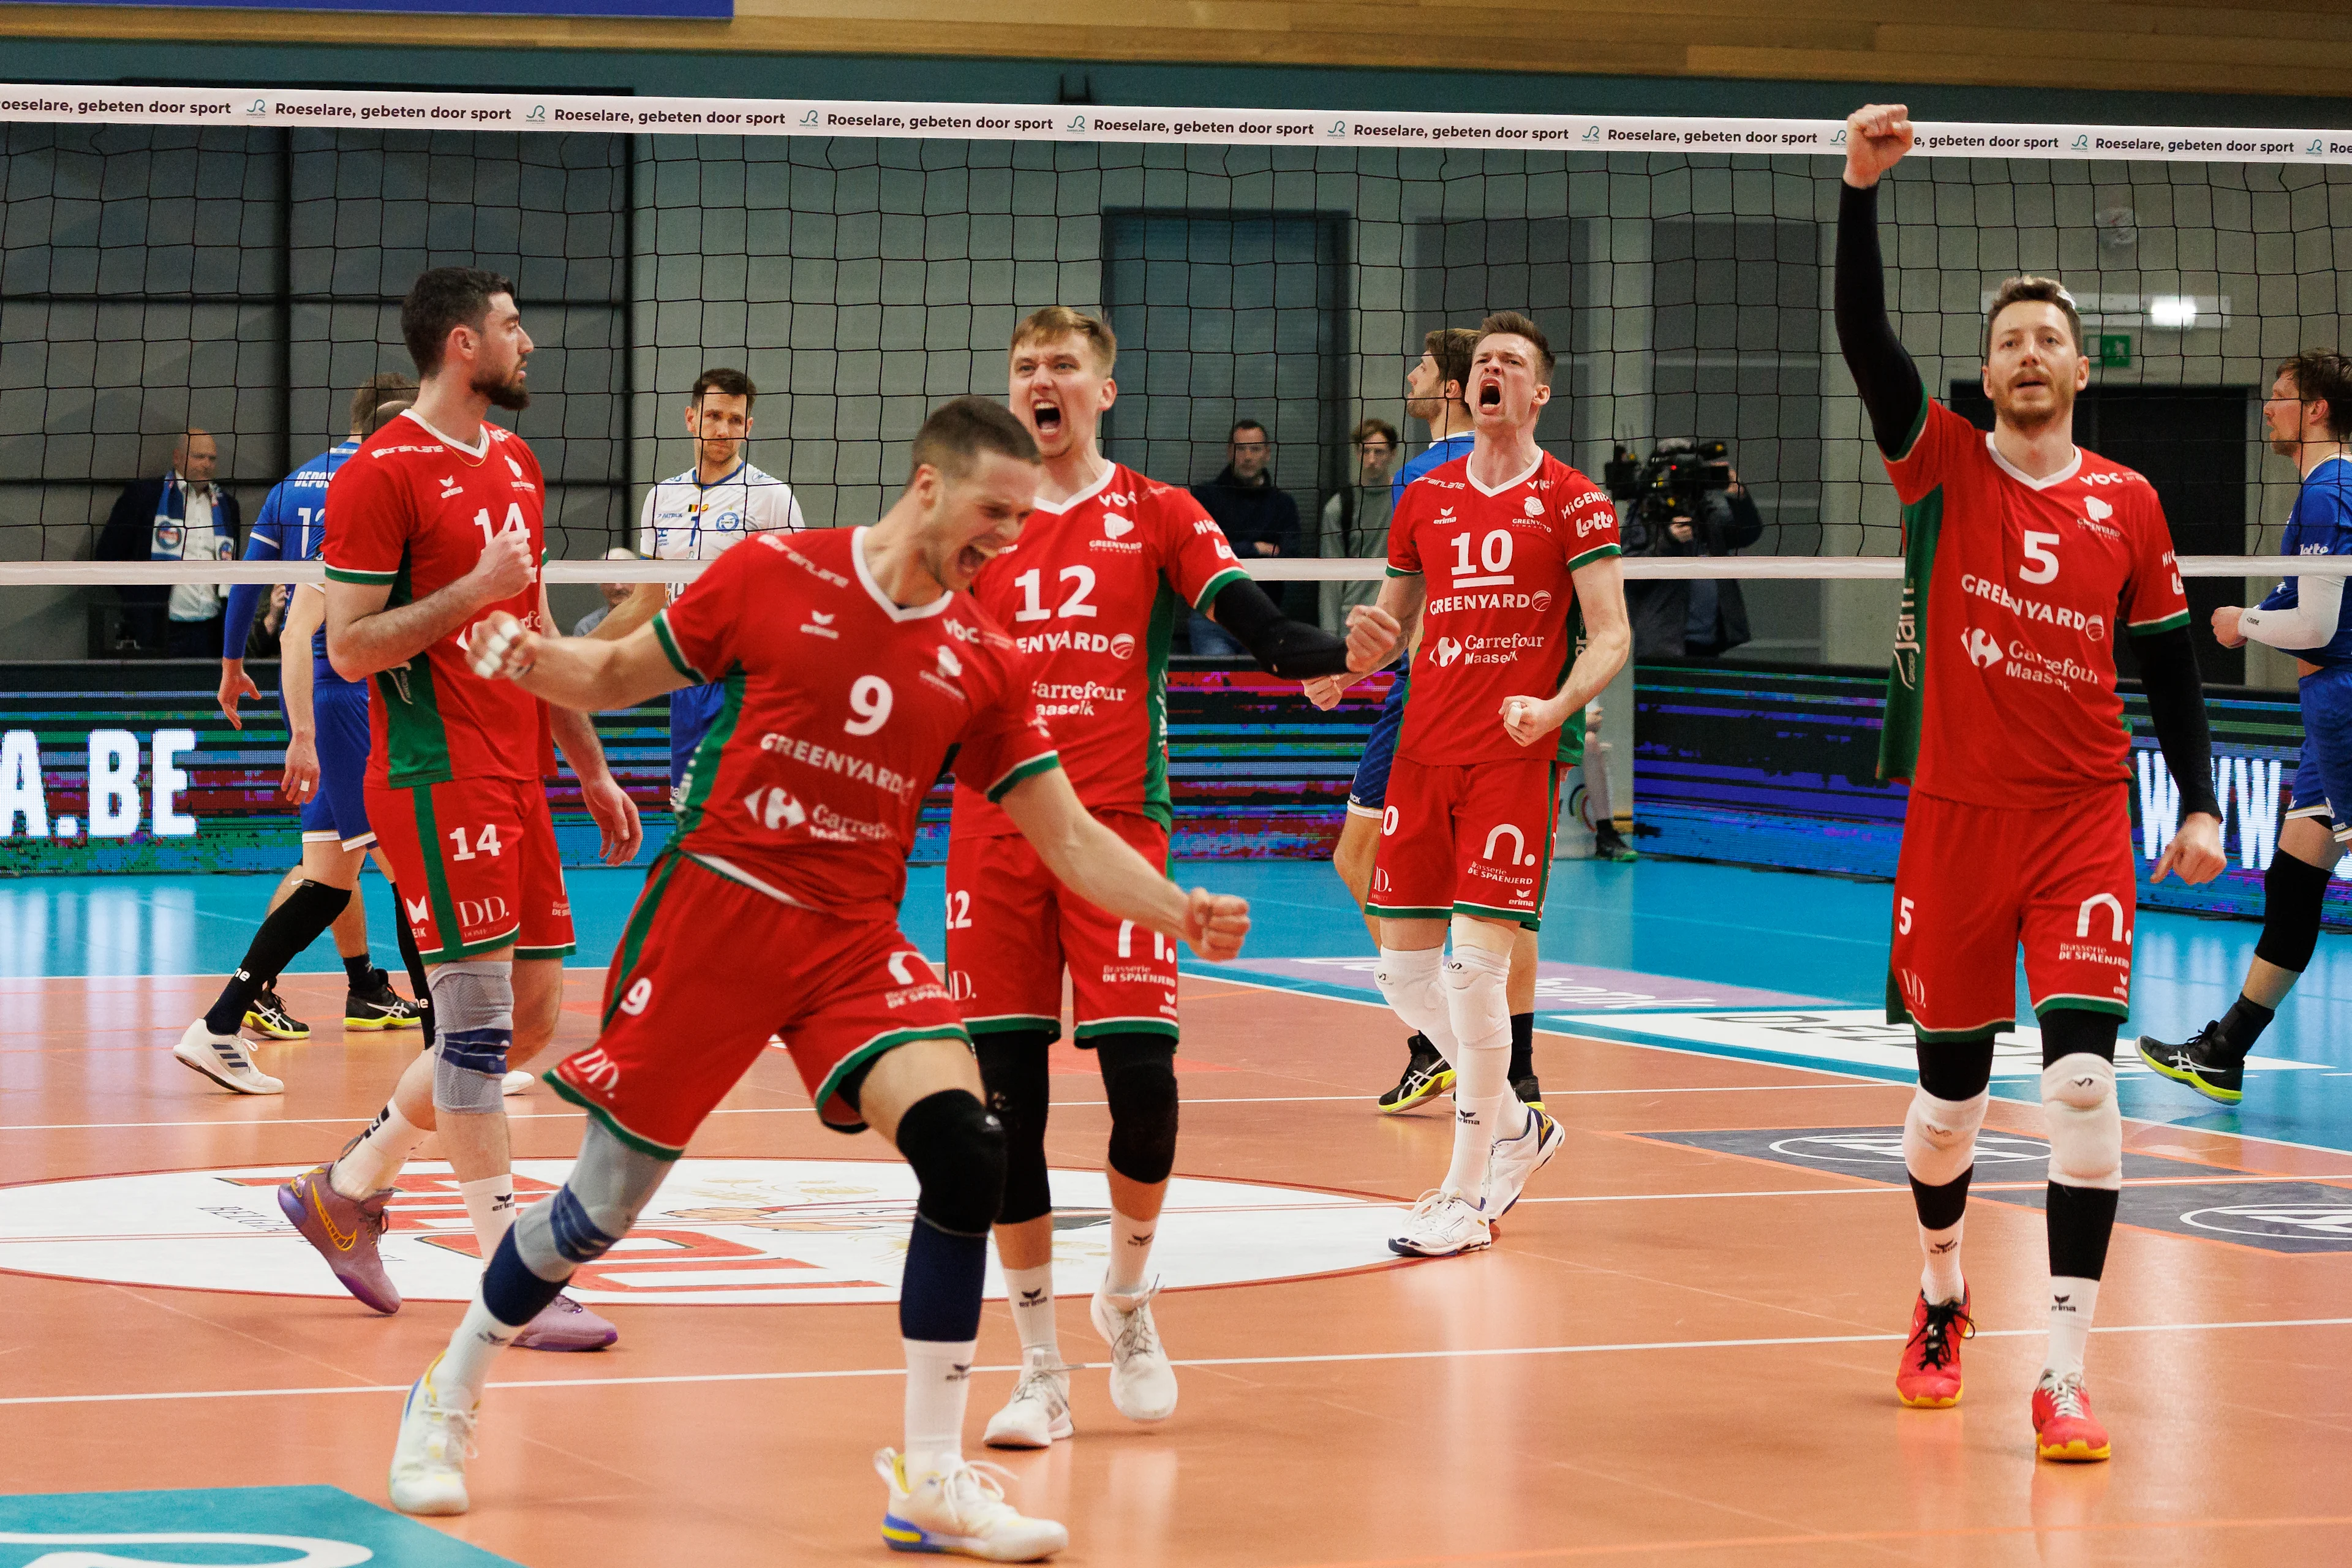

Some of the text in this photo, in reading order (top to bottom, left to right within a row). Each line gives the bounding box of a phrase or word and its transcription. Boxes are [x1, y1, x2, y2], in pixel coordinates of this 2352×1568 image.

[0, 99, 231, 116] oeselare, gebeten door sport
[276, 104, 355, 118] Roeselare,
[361, 105, 425, 119] gebeten
[431, 107, 466, 118] door
[471, 109, 511, 121] sport
[555, 108, 633, 123] Roeselare,
[639, 111, 701, 124] gebeten
[707, 111, 741, 124] door
[747, 114, 785, 127] sport
[828, 115, 904, 128] Roeselare,
[910, 116, 970, 129] gebeten
[976, 117, 1010, 129] door
[1015, 119, 1053, 132] sport
[1095, 119, 1169, 134] Roeselare,
[1174, 121, 1234, 135] gebeten
[1239, 122, 1272, 134] door
[1276, 124, 1313, 137] sport
[1354, 125, 1427, 138] Roeselare,
[1433, 126, 1490, 140] gebeten
[1496, 127, 1528, 139] door
[1532, 130, 1568, 141] sport
[1608, 130, 1817, 146] Roeselare, gebeten door sport
[1929, 135, 1985, 148] gebeten
[1989, 136, 2019, 148] door
[2024, 138, 2058, 151] sport
[2096, 138, 2294, 154] Roeselare, gebeten door sport
[2079, 472, 2123, 486] vbc
[1433, 516, 1457, 524] erima
[1450, 529, 1513, 576] 10
[2019, 530, 2059, 584] 5
[1015, 565, 1096, 621] 12
[1430, 594, 1531, 616] GREENYARD
[1961, 575, 2086, 631] GREENYARD
[1464, 633, 1544, 650] Carrefour
[1464, 650, 1518, 665] Maaseik
[845, 675, 892, 735] 9
[760, 733, 905, 794] GREENYARD
[1381, 805, 1399, 836] 0
[450, 824, 501, 861] 14
[1468, 867, 1533, 885] DE SPAENJERD
[1471, 861, 1507, 876] Brasserie
[946, 890, 972, 930] 12
[1899, 897, 1914, 935] 5
[2059, 951, 2072, 960] DE
[621, 978, 652, 1015] 9
[1457, 1114, 1480, 1126] erima
